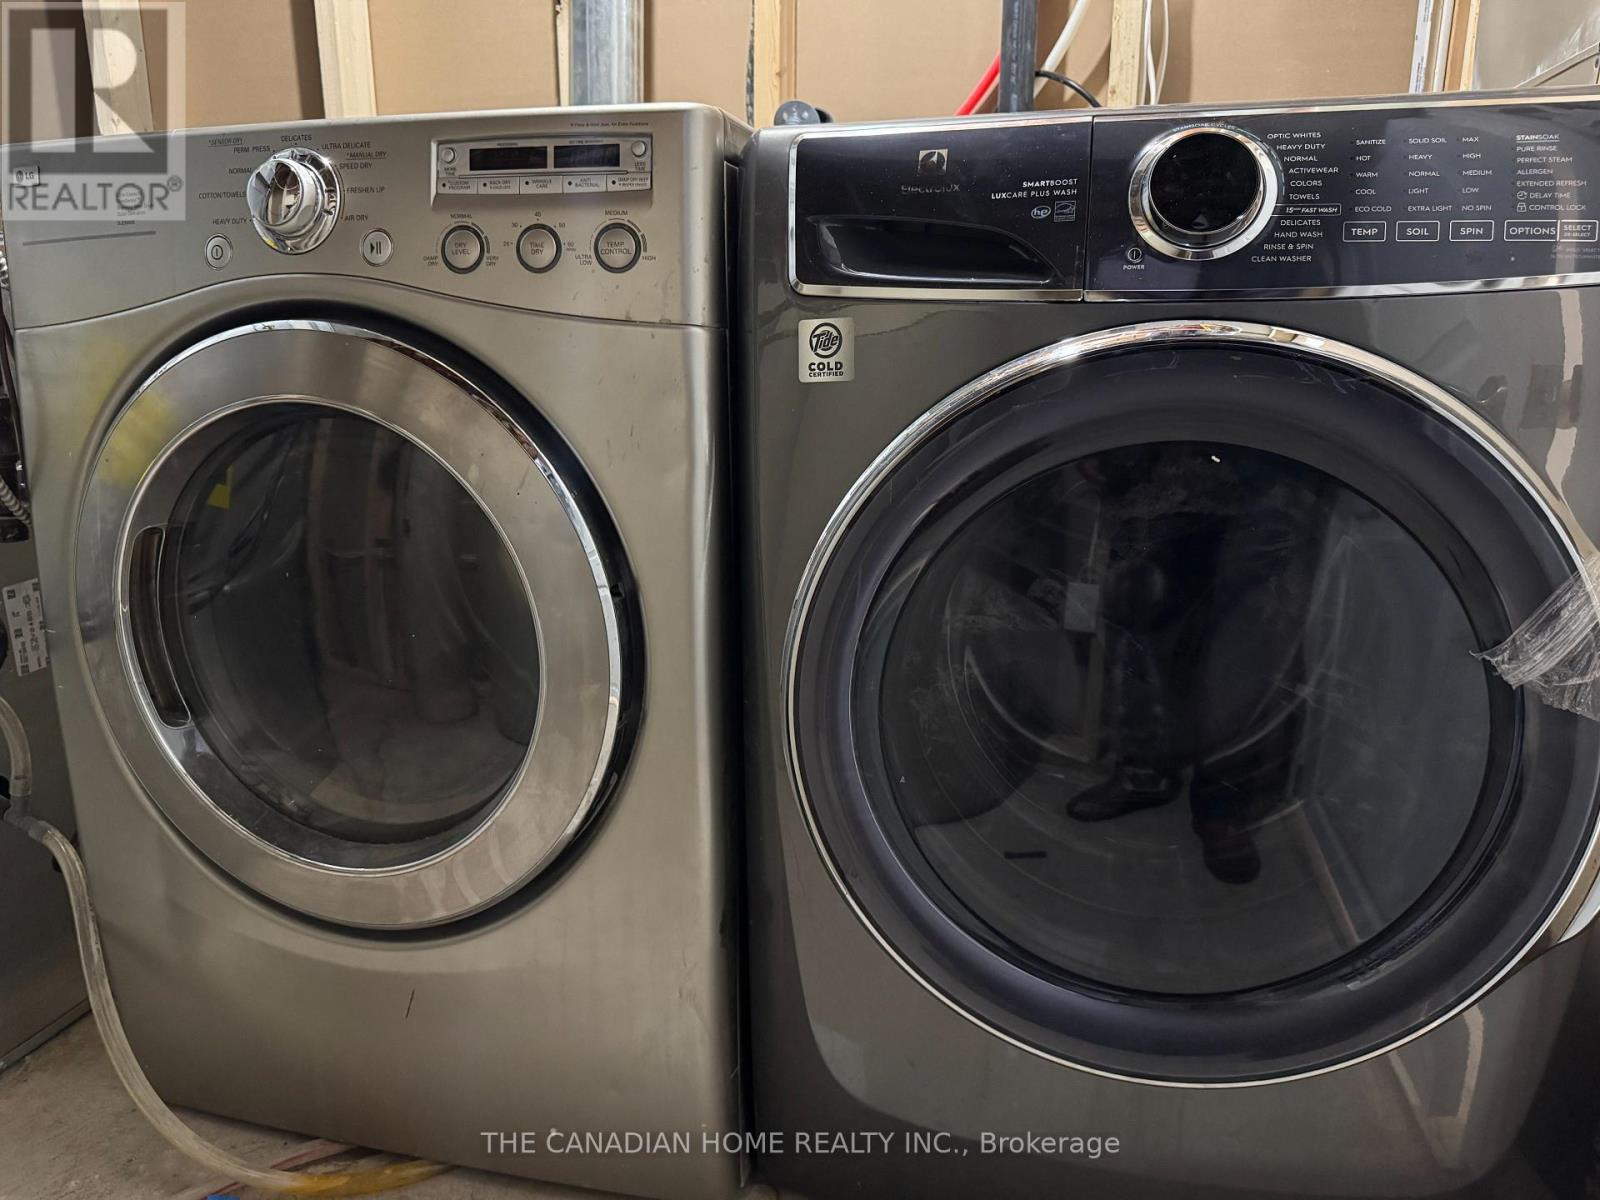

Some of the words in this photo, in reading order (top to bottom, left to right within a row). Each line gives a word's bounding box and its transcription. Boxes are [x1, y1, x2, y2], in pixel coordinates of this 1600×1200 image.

[280, 134, 312, 142] DELICATES
[1266, 132, 1290, 140] OPTIC
[322, 142, 341, 150] ULTRA
[1356, 138, 1387, 146] SANITIZE
[374, 150, 387, 158] DRY
[340, 162, 358, 170] SPEED
[1516, 168, 1554, 176] ALLERGEN
[1022, 178, 1078, 188] SMARTBOOST
[991, 191, 1028, 200] LUXCARE
[1030, 190, 1050, 198] PLUS
[1054, 188, 1077, 196] WASH
[232, 217, 247, 225] DUTY
[1351, 228, 1378, 236] TEMP
[1406, 228, 1429, 236] SOIL
[1509, 227, 1556, 235] OPTIONS
[1251, 255, 1276, 263] CLEAN
[812, 330, 839, 352] Tide
[808, 361, 844, 372] COLD
